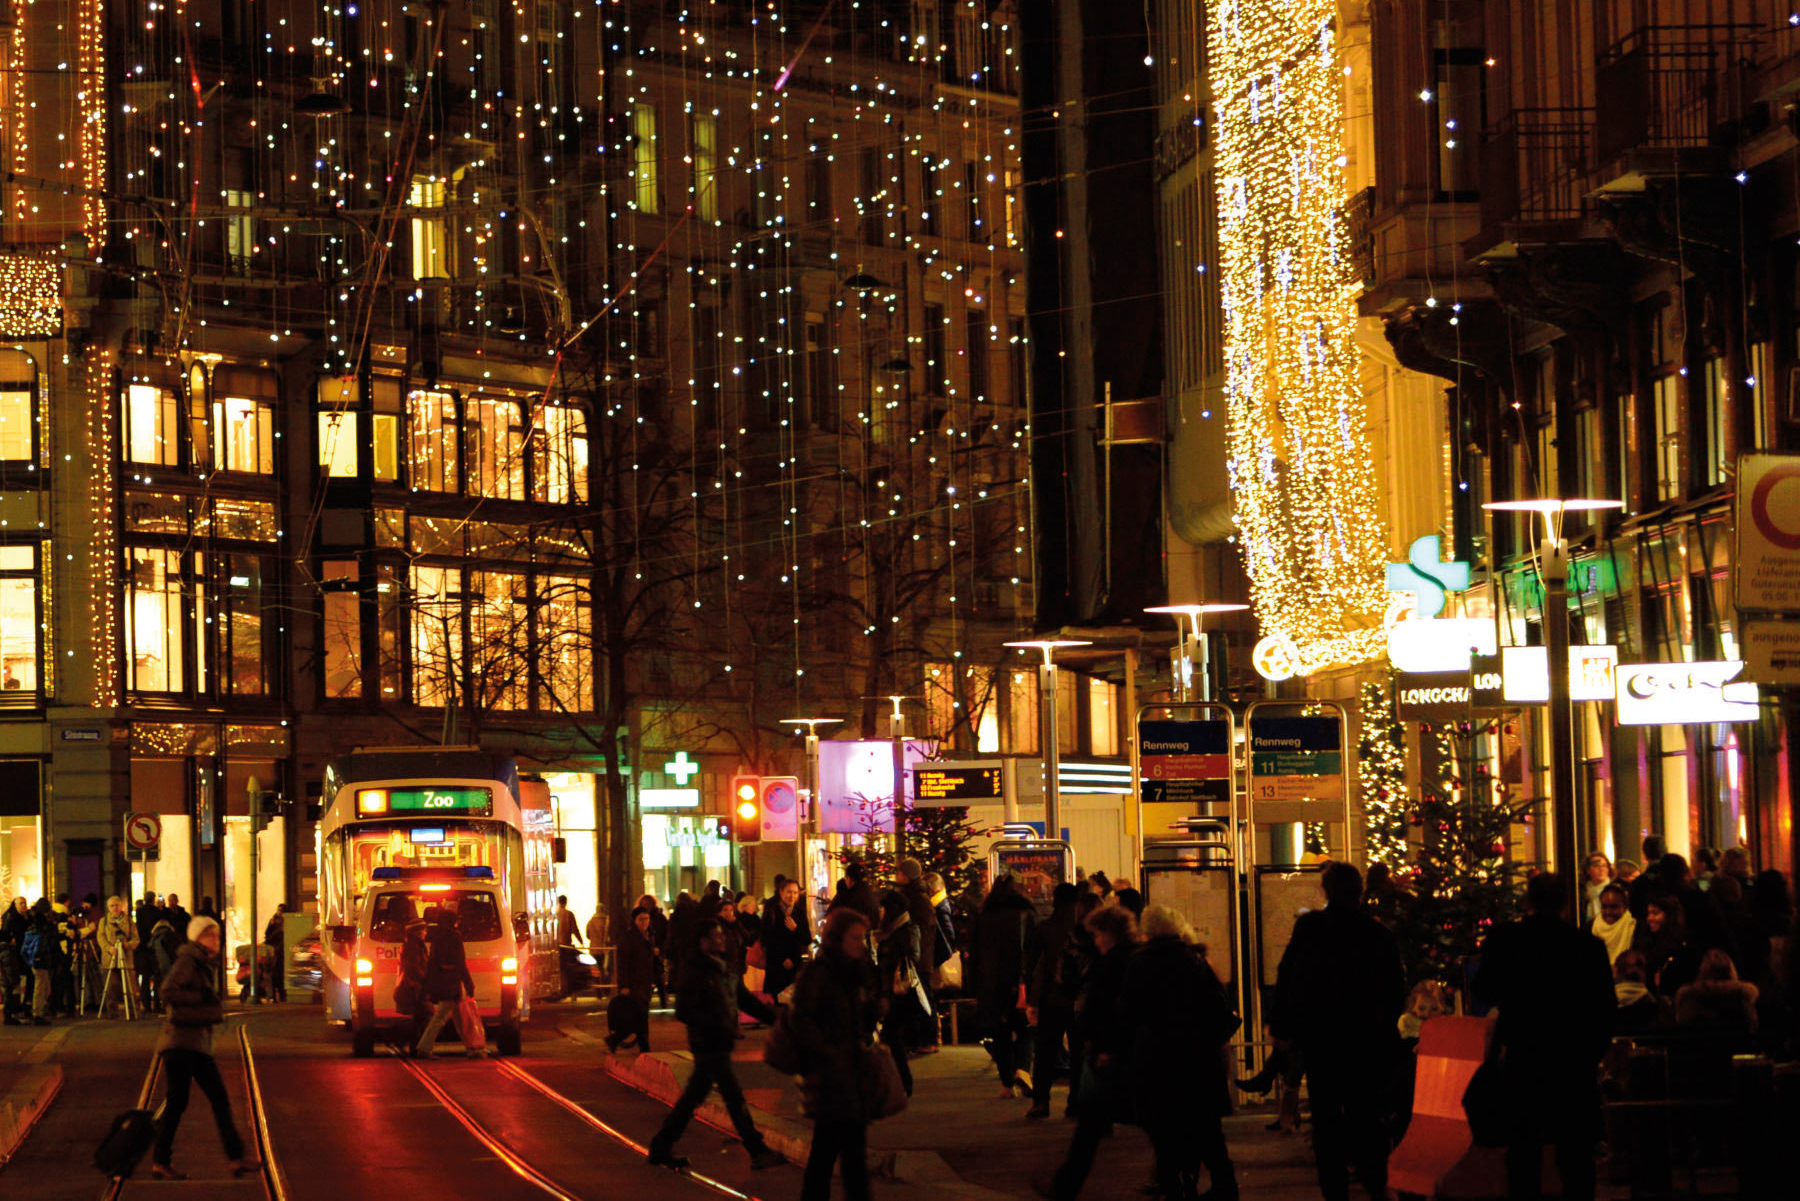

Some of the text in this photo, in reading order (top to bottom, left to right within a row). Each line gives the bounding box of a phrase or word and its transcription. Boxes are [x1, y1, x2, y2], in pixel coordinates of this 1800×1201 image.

[1143, 740, 1190, 751] Rennweg
[1255, 737, 1302, 747] Rennweg
[1153, 764, 1162, 777] 6
[1261, 761, 1275, 774] 11
[1154, 788, 1163, 801] 7
[1261, 785, 1275, 798] 13
[424, 791, 454, 808] Zoo
